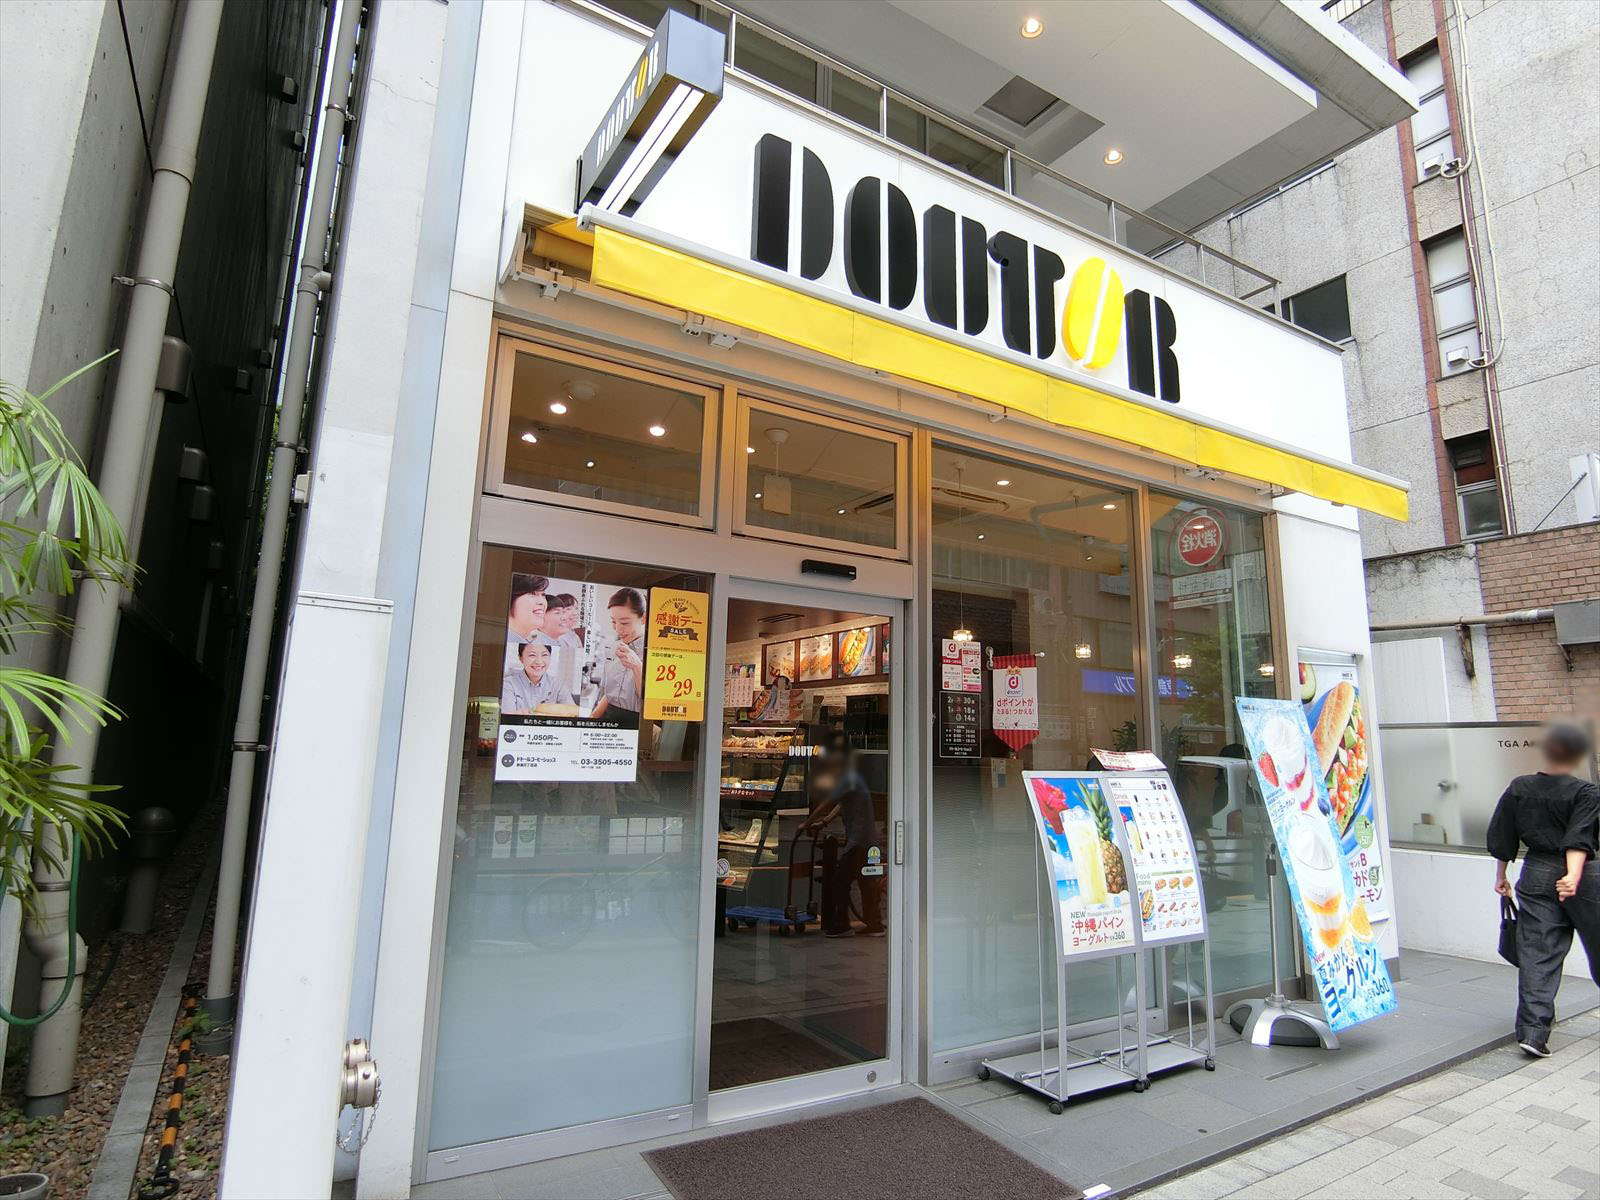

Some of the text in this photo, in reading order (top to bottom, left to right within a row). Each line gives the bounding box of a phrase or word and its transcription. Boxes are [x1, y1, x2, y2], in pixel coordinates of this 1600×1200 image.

[596, 40, 659, 168] DOUTOR
[750, 133, 1181, 404] DOUTOR
[655, 612, 703, 626] 感謝デー
[670, 627, 687, 635] SALE
[655, 664, 677, 682] 28
[673, 678, 693, 698] 29
[996, 697, 1034, 707] dポイントが
[788, 744, 824, 757] DOUTO
[1497, 740, 1520, 748] TGA
[580, 758, 632, 766] 03-3505-4550
[1360, 852, 1367, 867] B
[1353, 868, 1368, 888] カド
[1360, 887, 1383, 902] ーモン
[1070, 910, 1087, 919] NEW
[1071, 916, 1124, 935] 沖縄パイン
[1072, 932, 1109, 947] ヨーグルト
